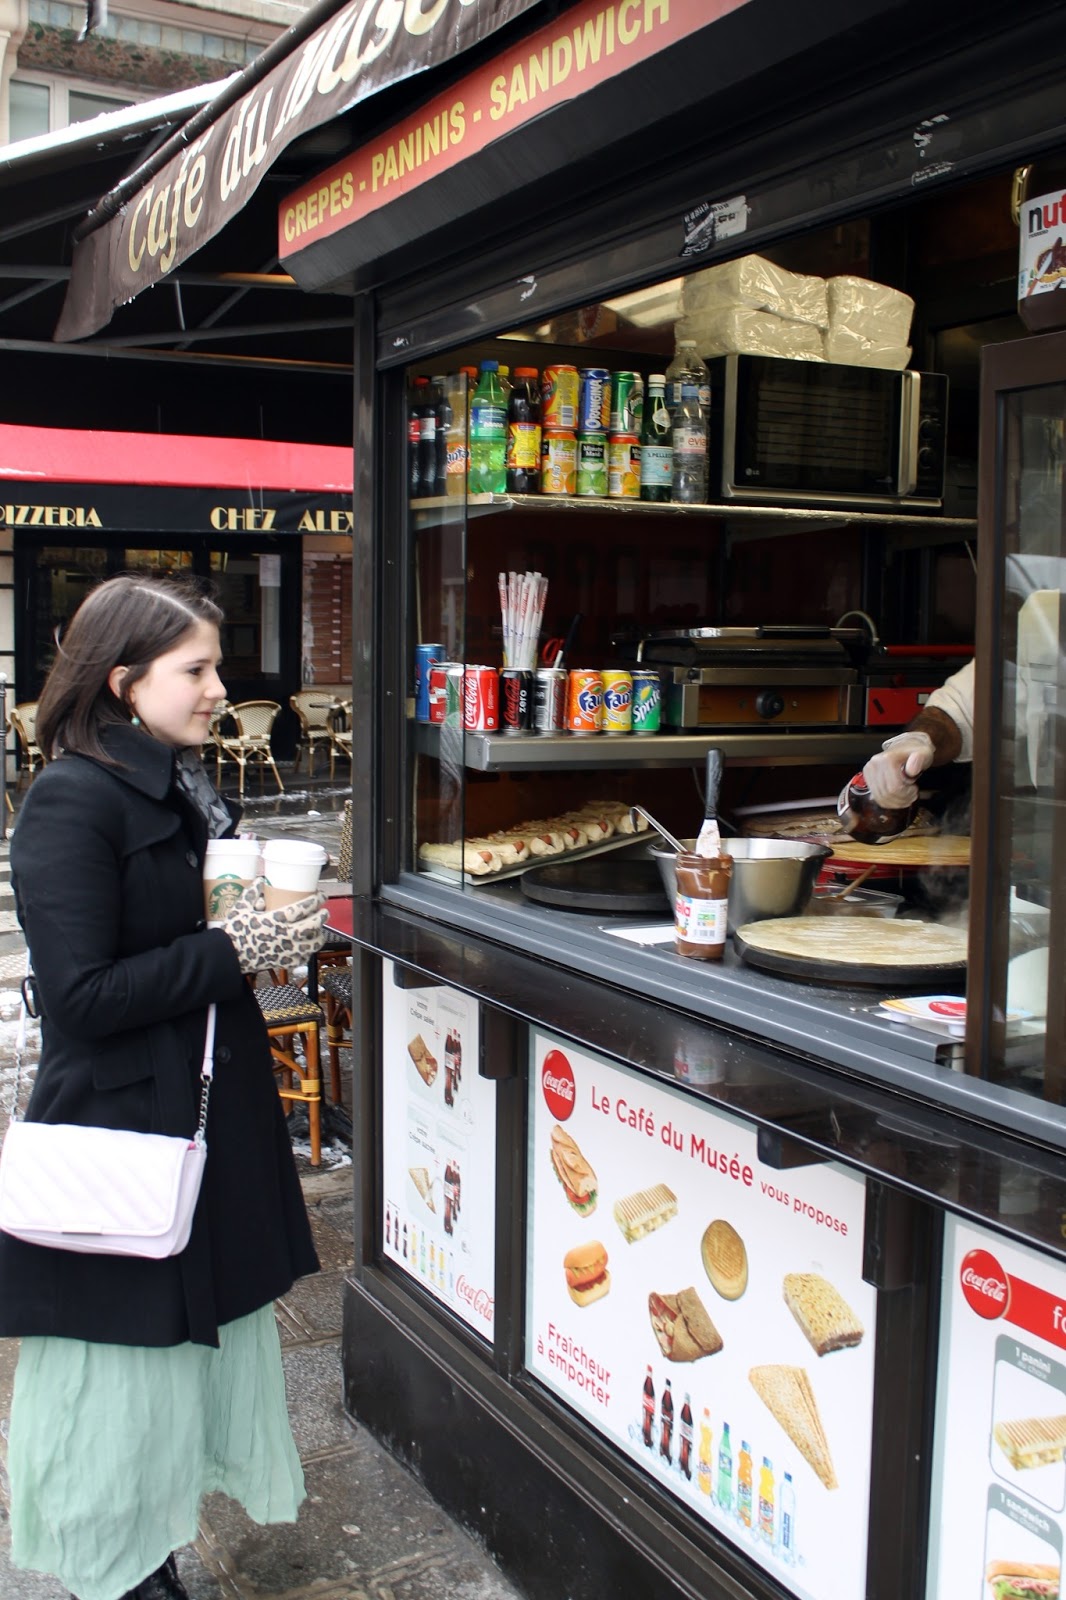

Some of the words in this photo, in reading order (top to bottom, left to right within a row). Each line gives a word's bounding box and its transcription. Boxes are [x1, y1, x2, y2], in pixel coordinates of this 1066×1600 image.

[284, 172, 354, 242] CREPES
[372, 101, 466, 192] PANINIS
[489, 0, 669, 121] SANDWICH
[128, 126, 214, 273] Café
[220, 86, 274, 202] du
[585, 378, 603, 429] ORANGINA
[210, 506, 276, 531] CHEZ
[518, 689, 528, 713] zero
[591, 1085, 610, 1115] Le
[616, 1098, 655, 1137] Café
[661, 1121, 683, 1152] du
[690, 1133, 753, 1187] Musée
[760, 1181, 790, 1206] vous
[793, 1197, 849, 1236] propose
[537, 1334, 544, 1355] à
[548, 1348, 610, 1407] emporter
[548, 1322, 611, 1386] Fraîcheur
[1021, 1351, 1051, 1374] panini
[1006, 1498, 1050, 1533] sandwich
